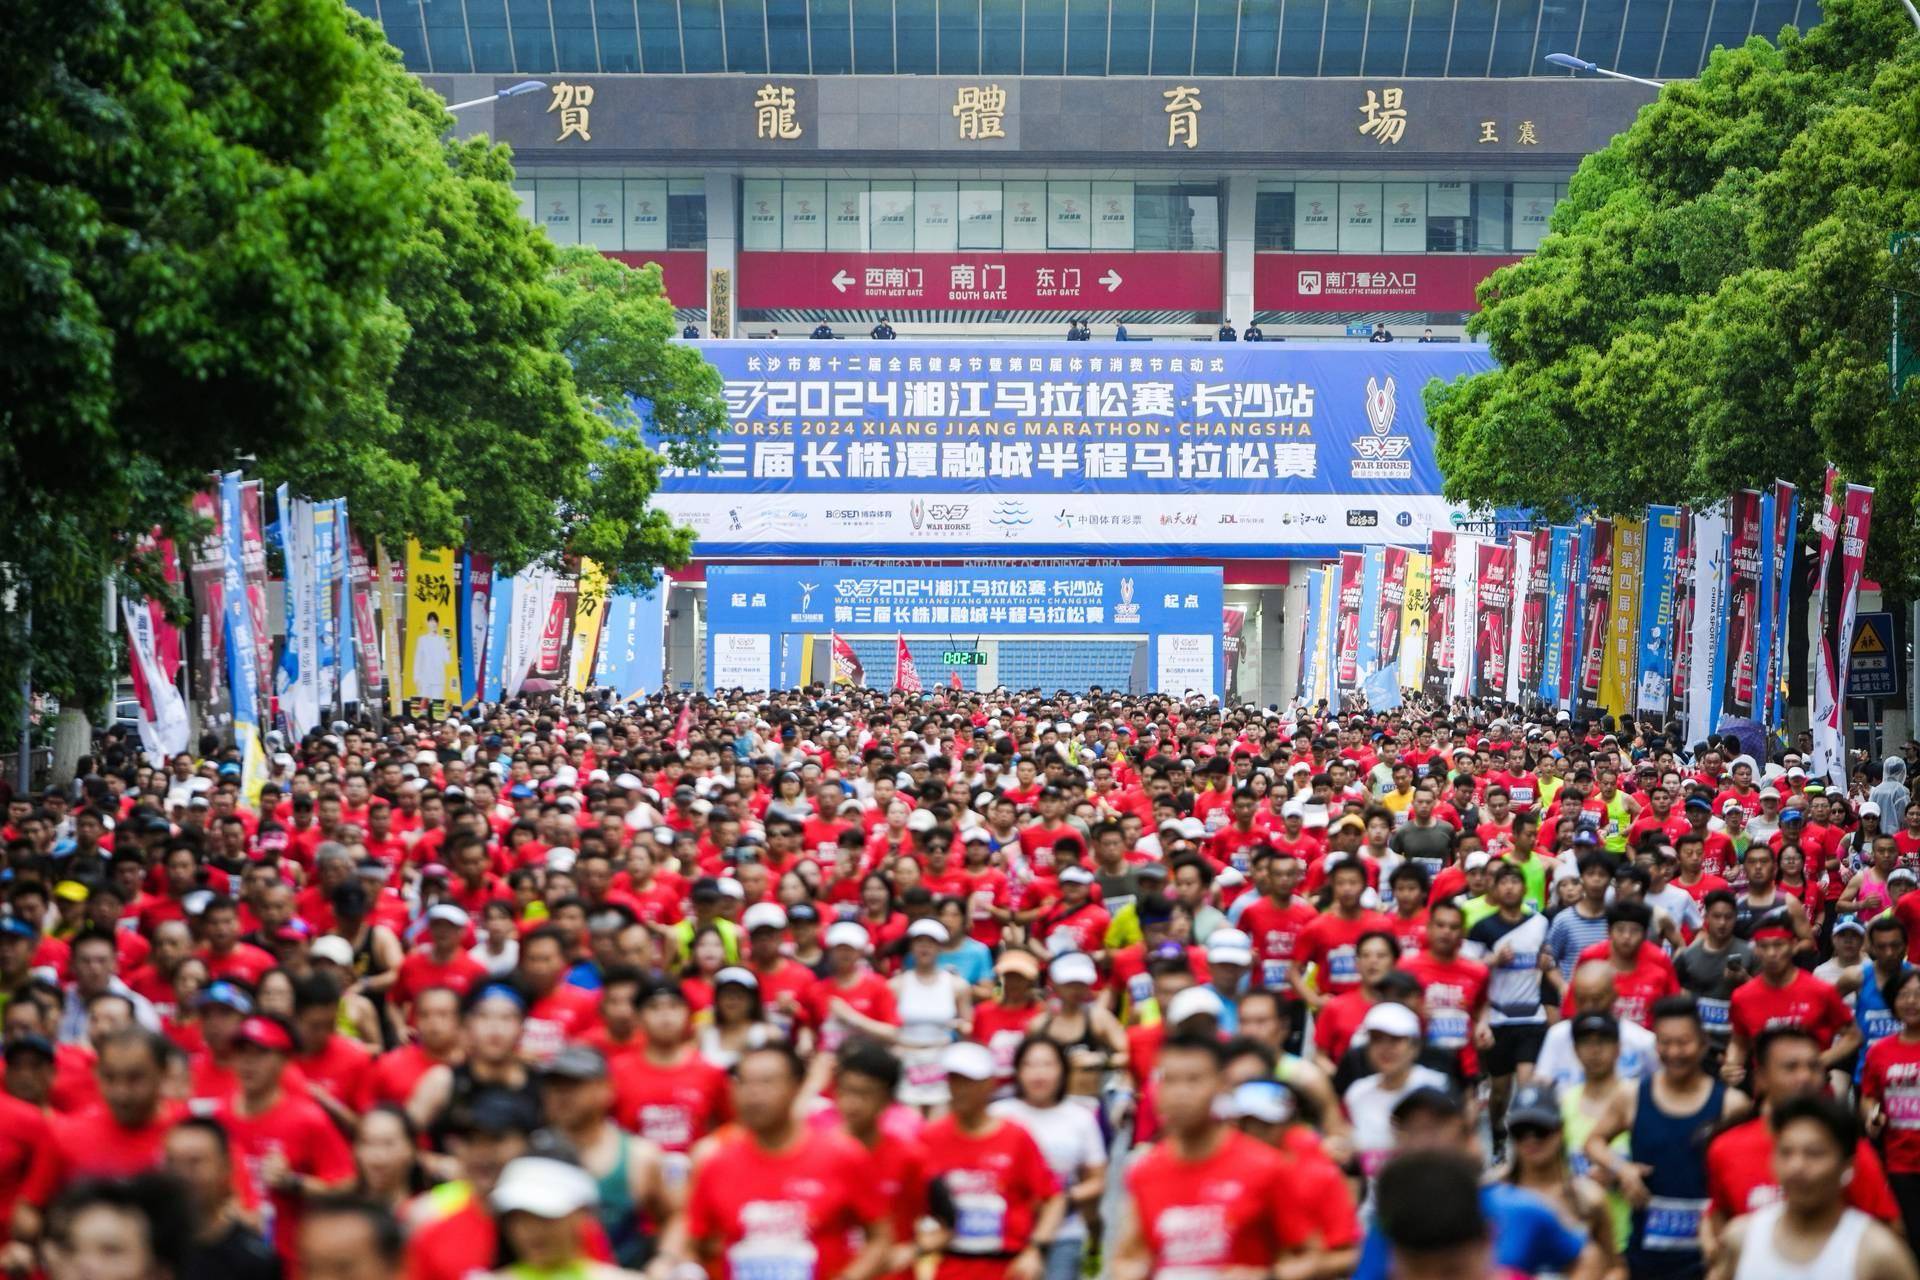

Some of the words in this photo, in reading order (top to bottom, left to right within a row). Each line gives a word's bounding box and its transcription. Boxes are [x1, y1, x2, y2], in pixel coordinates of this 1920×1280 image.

[1479, 120, 1538, 146] 王震
[865, 268, 924, 288] 西南门
[951, 264, 1006, 290] 南门
[1036, 268, 1081, 288] 东门
[1326, 272, 1416, 287] 南门看台入口
[865, 289, 887, 297] SOUTH
[949, 291, 980, 300] SOUTH
[983, 291, 1007, 300] GATE
[1037, 289, 1057, 297] EAST
[1060, 289, 1080, 297] GATE
[748, 357, 1224, 372] 长沙市第十二届全民健身节暨第四届体育消费节启动式
[733, 422, 793, 435] ORSE
[801, 422, 855, 435] 2024
[863, 422, 937, 435] XIANG
[946, 422, 1016, 436] JIANG
[1179, 422, 1312, 436] CHANGSHA
[1353, 461, 1374, 469] WAR
[1376, 461, 1409, 469] HORSE
[926, 523, 943, 531] WAR
[944, 523, 971, 531] HORSE
[731, 593, 767, 608] 起点
[1047, 597, 1103, 605] CHANGSHA
[1163, 593, 1199, 609] 起点
[1707, 615, 1716, 651] SPORTS
[943, 652, 986, 665] 0:02:17
[1706, 652, 1715, 691] LOTTERY
